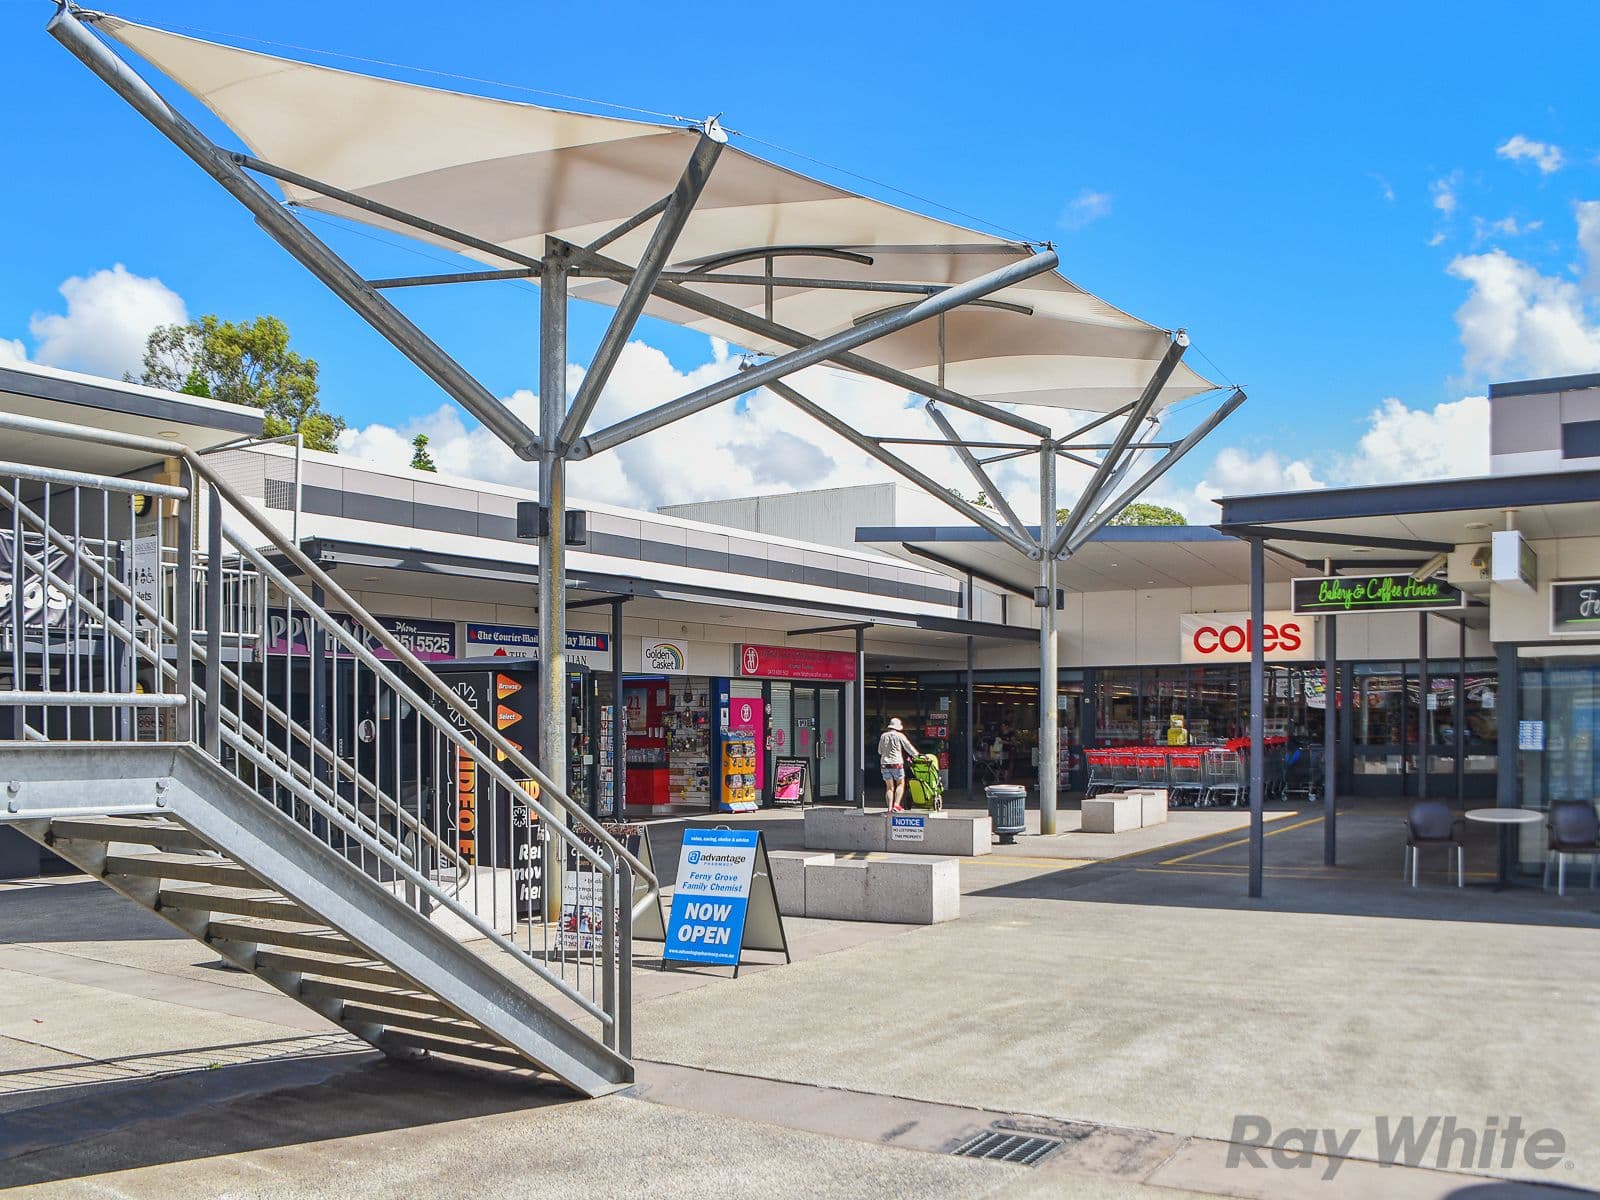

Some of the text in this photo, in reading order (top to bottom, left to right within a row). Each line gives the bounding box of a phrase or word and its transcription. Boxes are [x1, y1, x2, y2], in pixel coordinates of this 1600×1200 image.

[1318, 579, 1353, 609] Bakery
[1367, 578, 1402, 602] Coffee
[1404, 577, 1438, 597] House
[394, 621, 417, 633] Phone
[477, 630, 492, 640] The
[578, 635, 597, 647] Mail
[1193, 619, 1301, 653] coles
[416, 635, 451, 654] 5525
[645, 648, 670, 660] Golden
[652, 658, 674, 670] Casket
[498, 713, 515, 721] Select
[895, 818, 920, 826] NOTICE
[700, 853, 746, 865] advantage
[689, 872, 738, 882] Ferny Grove
[682, 881, 743, 892] Family Chemist
[684, 902, 732, 922] NOW
[677, 924, 731, 945] OPEN
